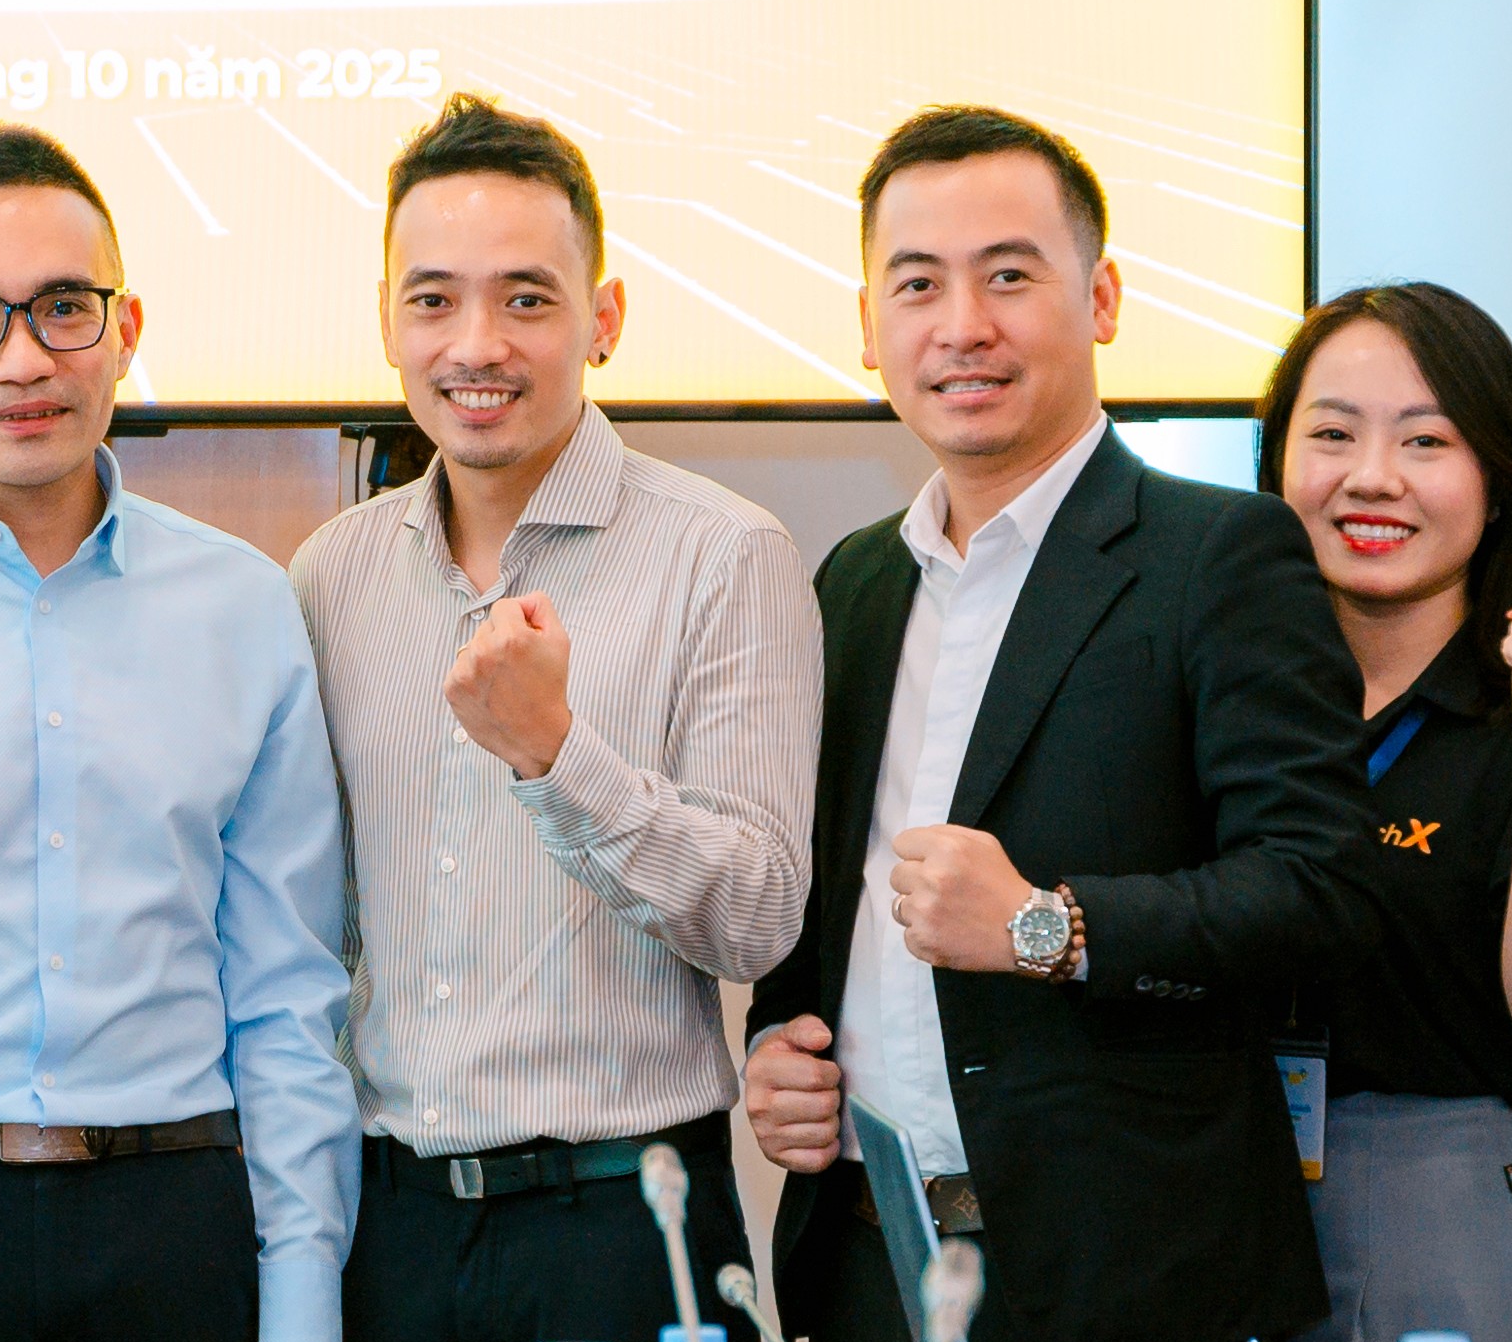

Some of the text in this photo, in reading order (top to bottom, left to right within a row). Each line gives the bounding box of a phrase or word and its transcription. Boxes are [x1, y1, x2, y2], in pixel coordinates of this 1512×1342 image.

[63, 49, 128, 100] 10
[143, 47, 281, 100] năm
[296, 49, 442, 100] 2025
